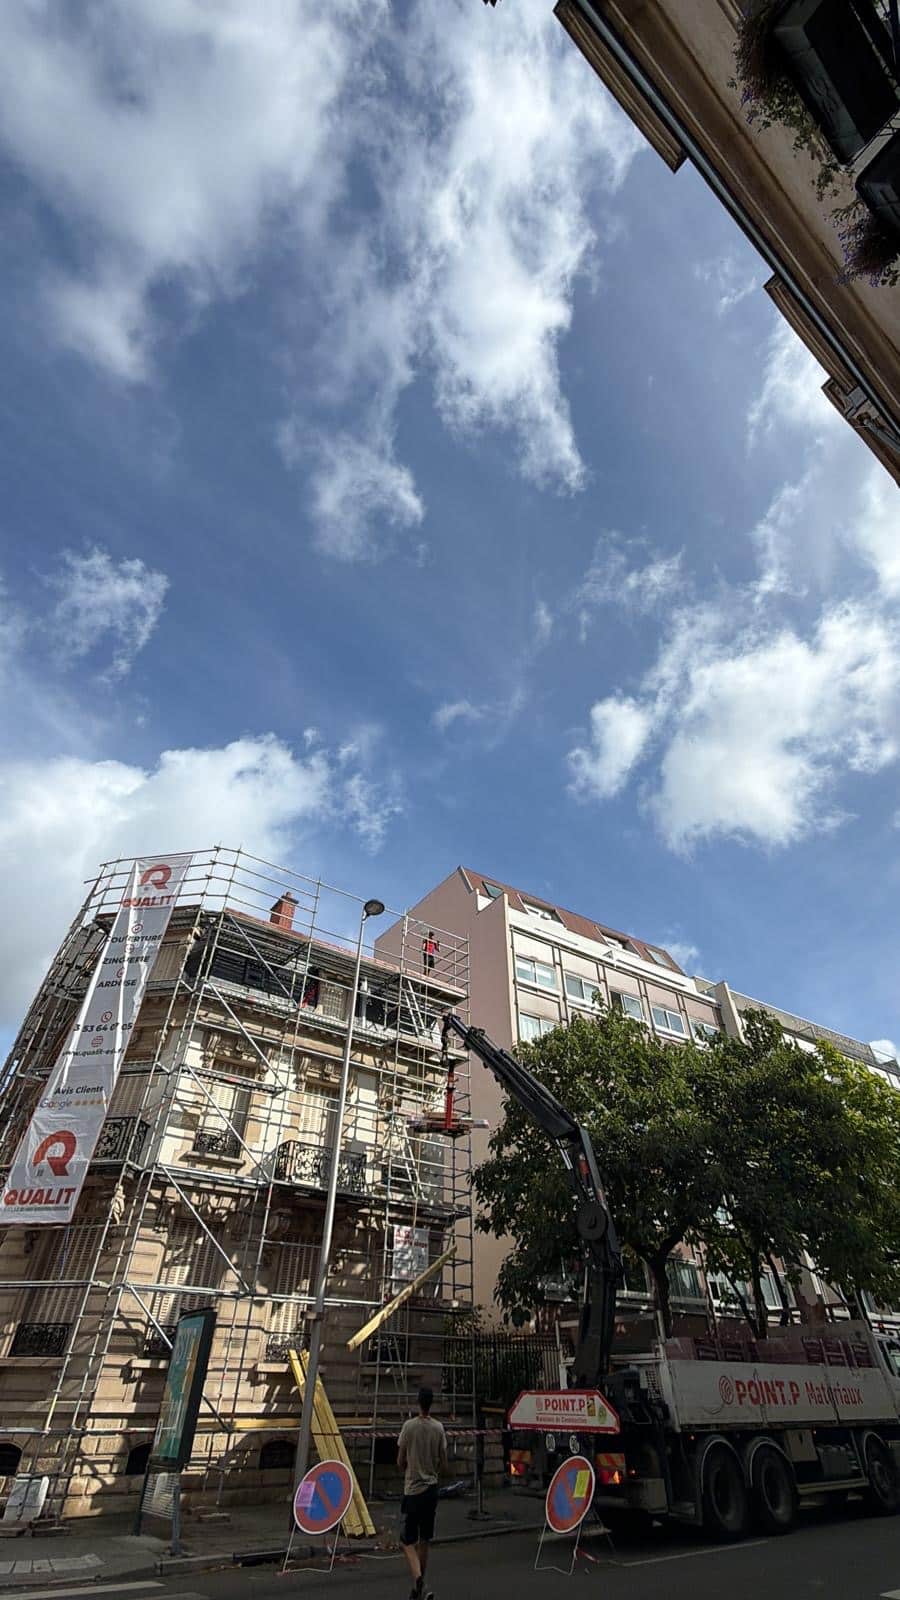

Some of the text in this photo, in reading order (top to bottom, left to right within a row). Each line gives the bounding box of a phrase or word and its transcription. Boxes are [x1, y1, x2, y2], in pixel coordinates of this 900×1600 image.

[122, 895, 174, 907] QUALIT
[97, 979, 137, 988] ARDOSE
[82, 1025, 94, 1033] 53
[96, 1024, 108, 1032] 64
[54, 1085, 104, 1095] Avis Clients
[4, 1187, 77, 1206] QUALIT
[735, 1380, 800, 1406] POINT.P
[544, 1399, 586, 1412] POINT.P
